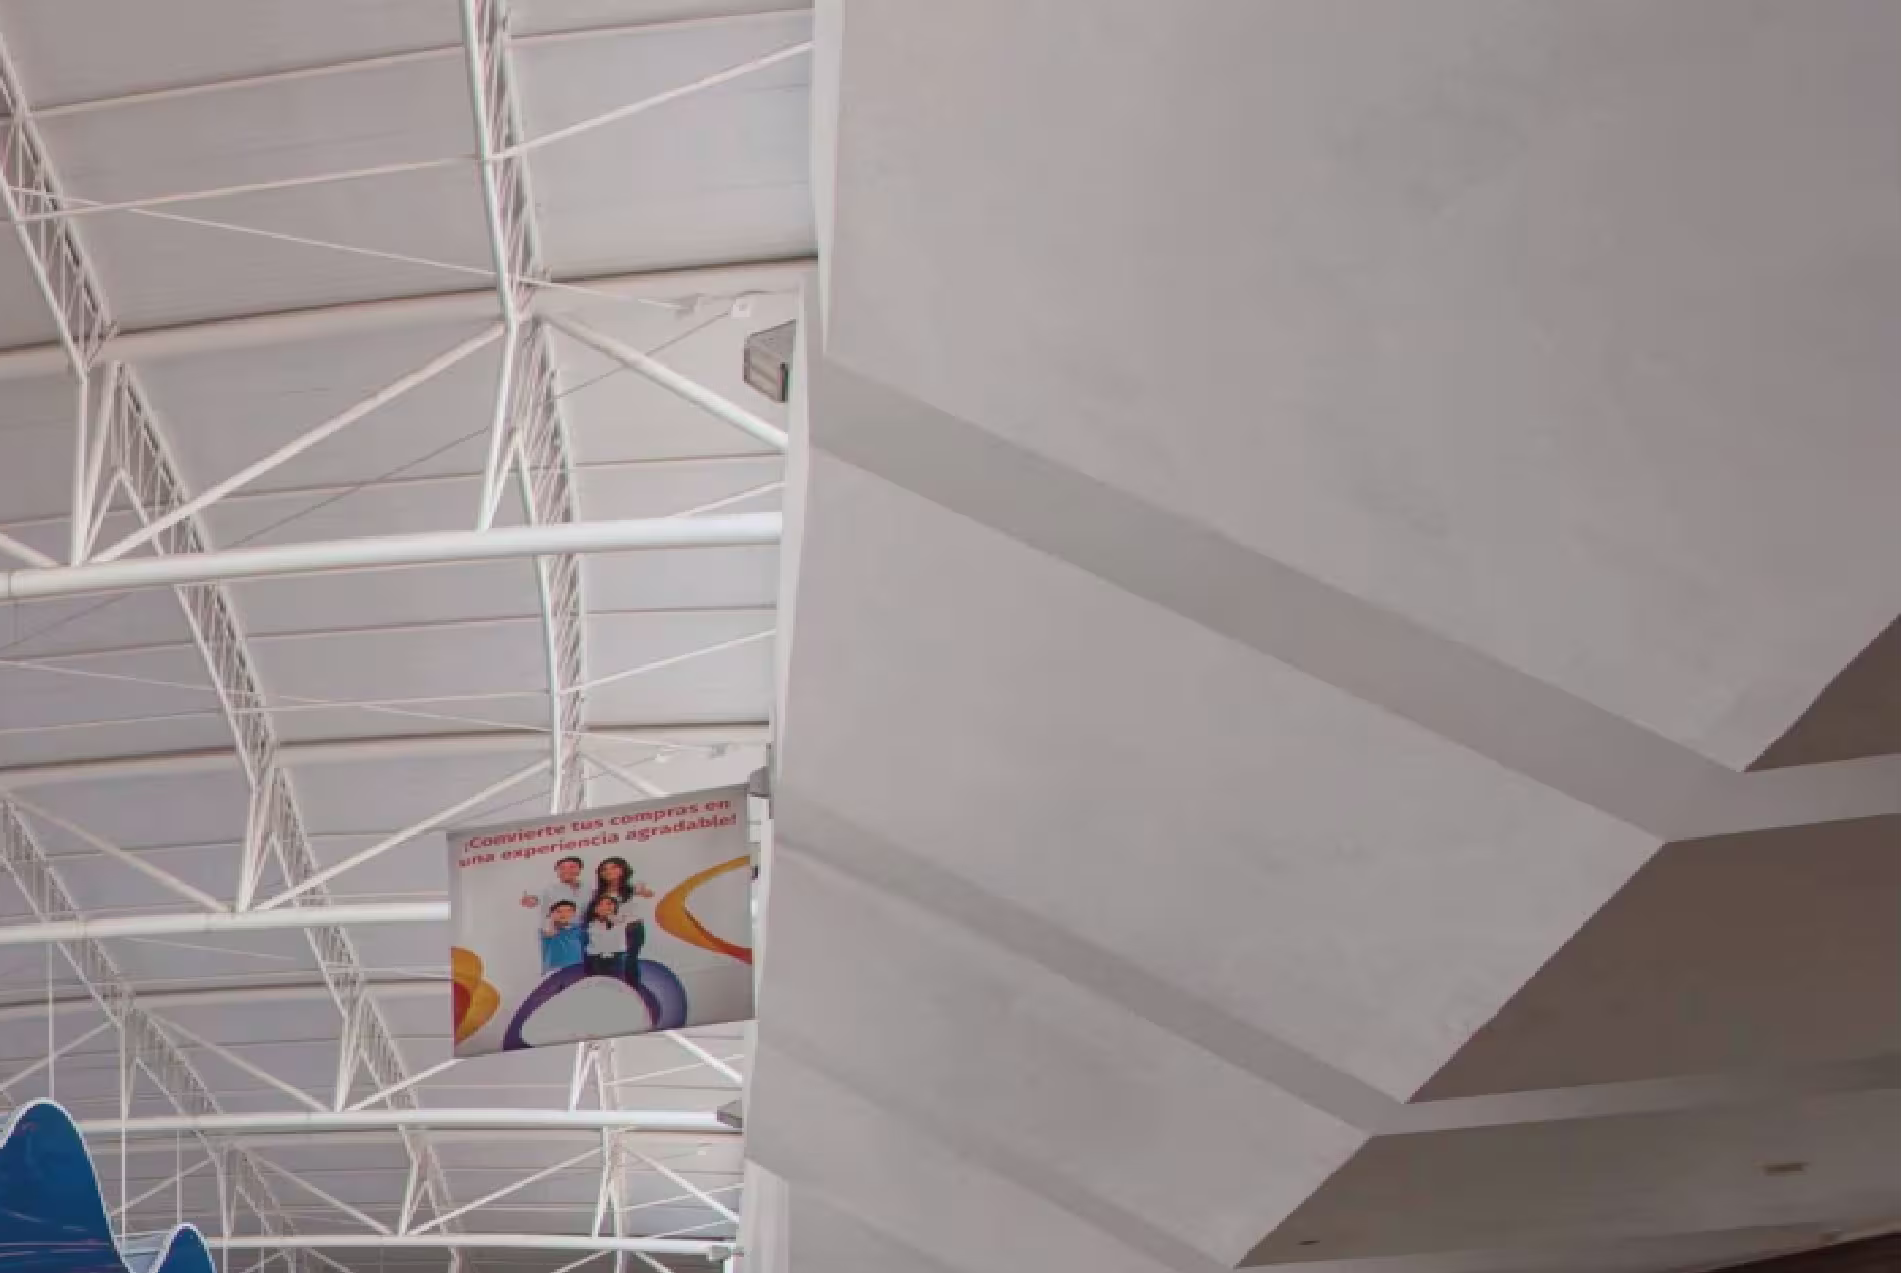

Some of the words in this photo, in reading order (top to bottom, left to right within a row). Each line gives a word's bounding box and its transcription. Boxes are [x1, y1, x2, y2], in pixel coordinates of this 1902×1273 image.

[570, 818, 604, 832] tus
[610, 803, 699, 827] compras
[704, 799, 732, 811] en
[458, 852, 495, 868] una
[500, 831, 620, 861] experiencia
[624, 813, 737, 842] agradable!
